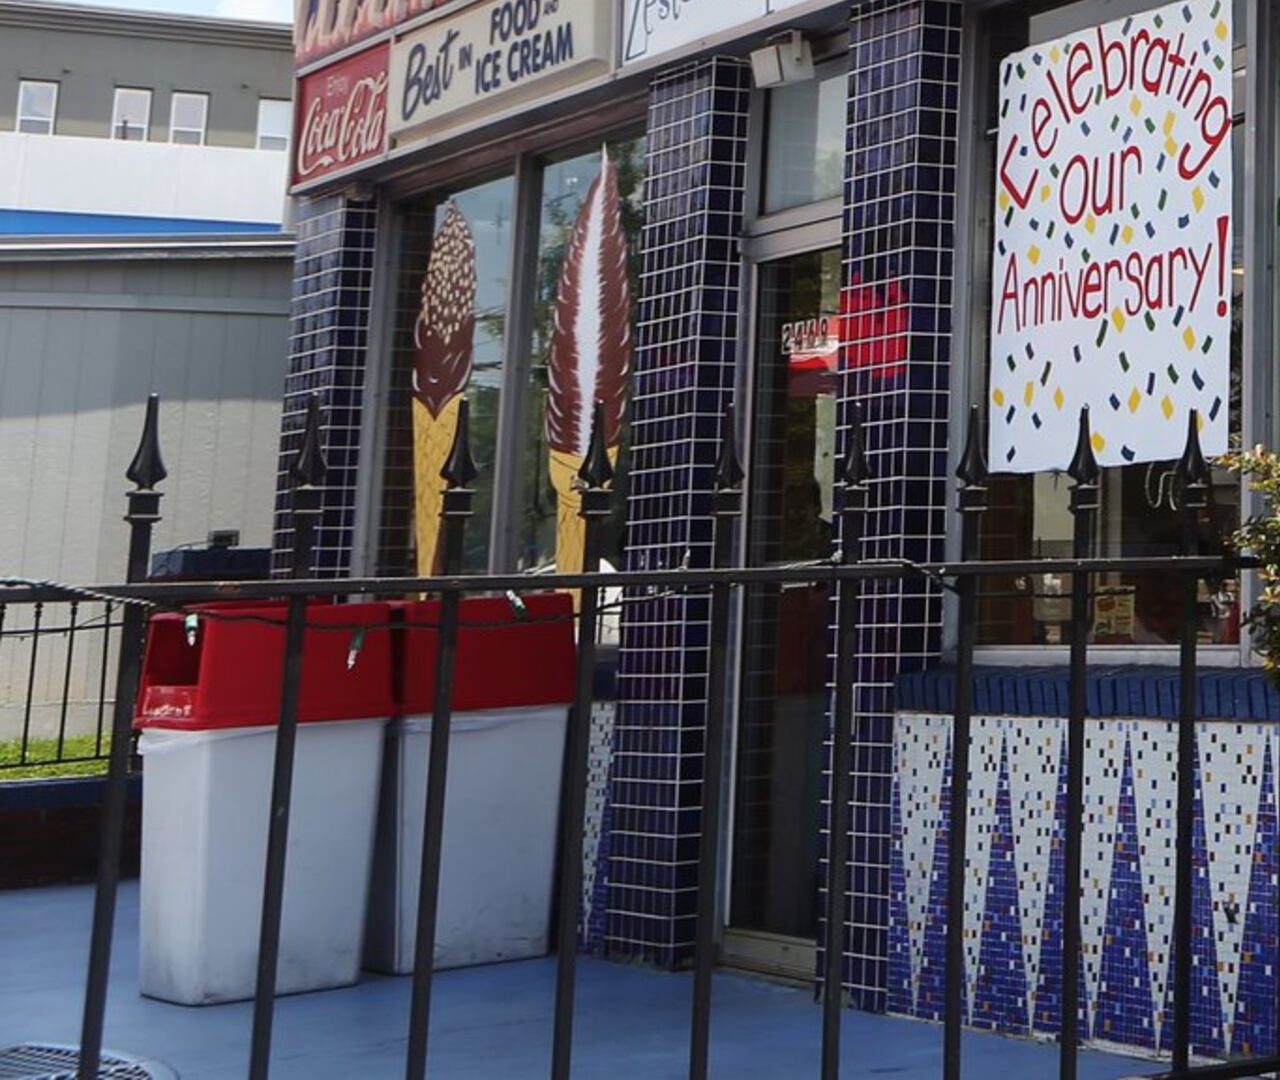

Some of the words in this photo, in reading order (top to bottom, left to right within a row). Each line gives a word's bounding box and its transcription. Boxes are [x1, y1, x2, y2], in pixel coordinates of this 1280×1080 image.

[402, 29, 460, 121] Best
[458, 43, 474, 71] IN
[475, 50, 502, 95] ICE
[507, 21, 574, 82] CREAM
[297, 70, 389, 176] Coca-Cola
[999, 25, 1232, 210] Celebrating
[1059, 145, 1142, 223] our
[997, 215, 1230, 334] Anniversary!
